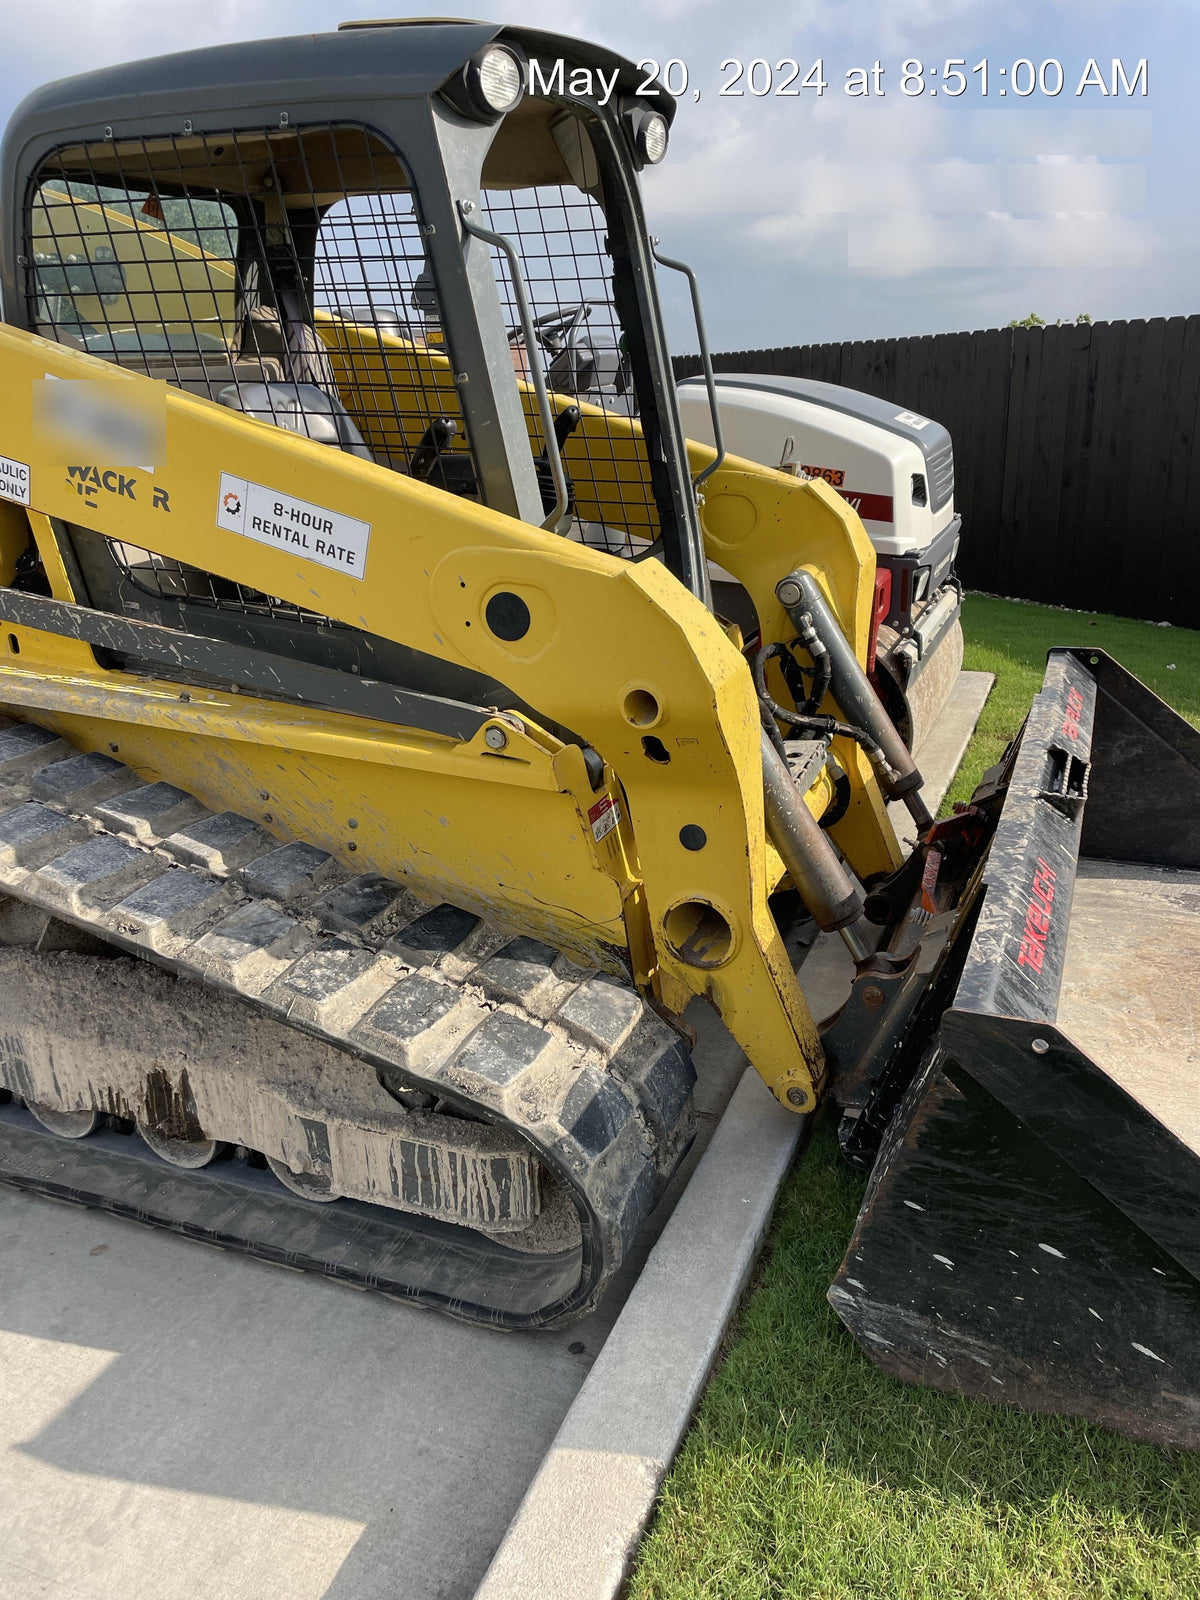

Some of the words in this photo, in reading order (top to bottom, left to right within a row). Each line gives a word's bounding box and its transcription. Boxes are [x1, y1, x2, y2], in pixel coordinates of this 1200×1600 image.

[0, 462, 27, 481] ULIC
[273, 502, 333, 535] 8-HOUR
[252, 516, 310, 549] RENTAL
[316, 539, 356, 565] RATE
[1017, 856, 1057, 975] TAKEUCHI
